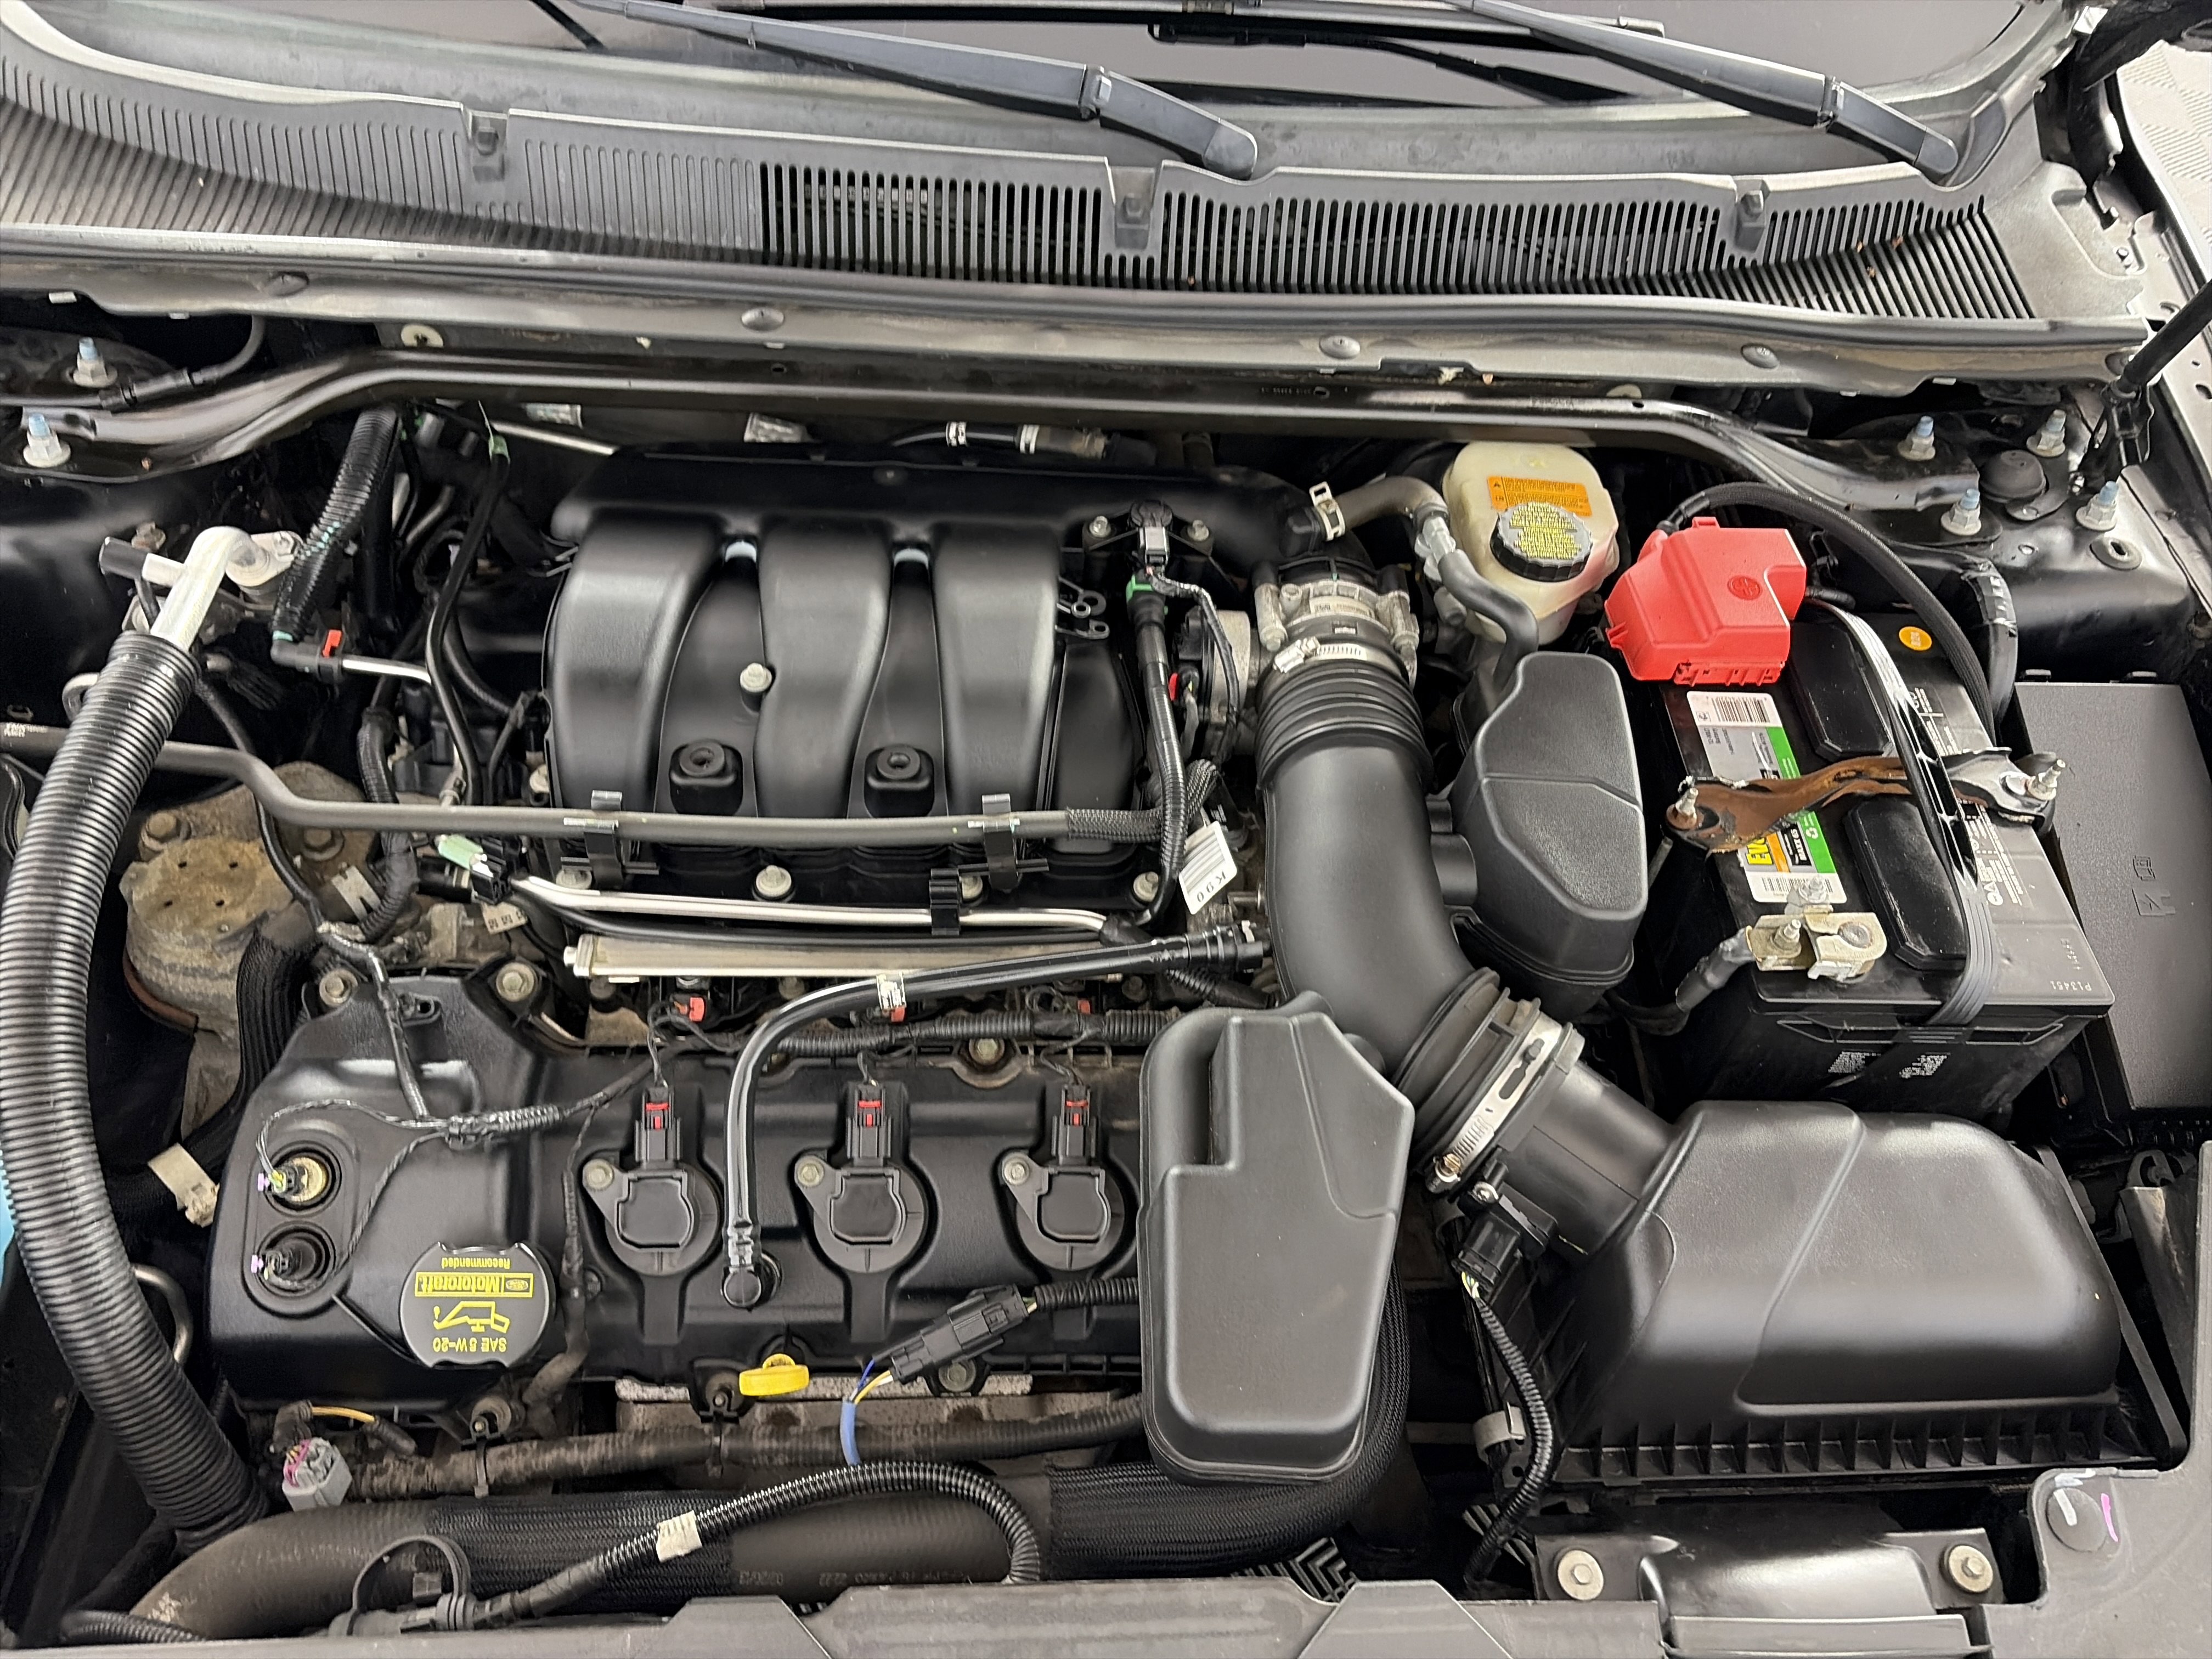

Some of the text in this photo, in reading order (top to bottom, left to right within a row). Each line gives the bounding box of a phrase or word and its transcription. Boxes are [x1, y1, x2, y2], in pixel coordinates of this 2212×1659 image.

[2050, 981, 2092, 991] P13451
[441, 1257, 510, 1269] Recommended
[481, 1337, 507, 1352] SAE
